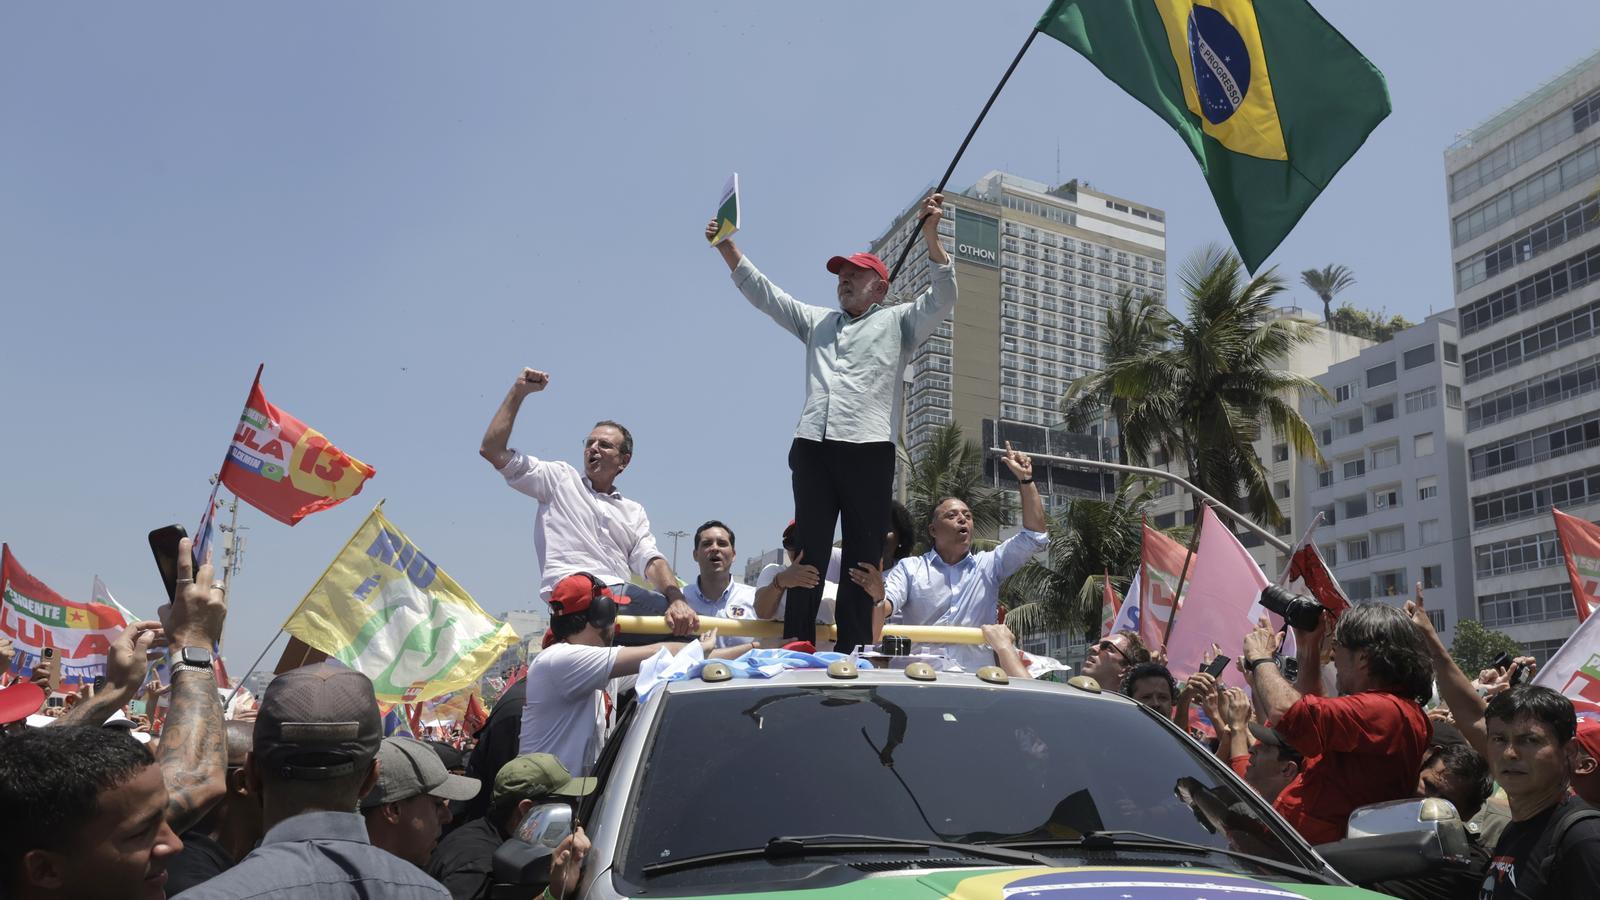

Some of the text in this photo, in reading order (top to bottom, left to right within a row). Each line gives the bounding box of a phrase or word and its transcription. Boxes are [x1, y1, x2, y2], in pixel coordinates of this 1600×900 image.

[1204, 49, 1241, 105] PROGRESSO
[959, 243, 996, 260] OTHON
[235, 424, 285, 460] ULA
[299, 436, 352, 482] 13
[731, 606, 744, 616] 13
[0, 606, 112, 659] LULA
